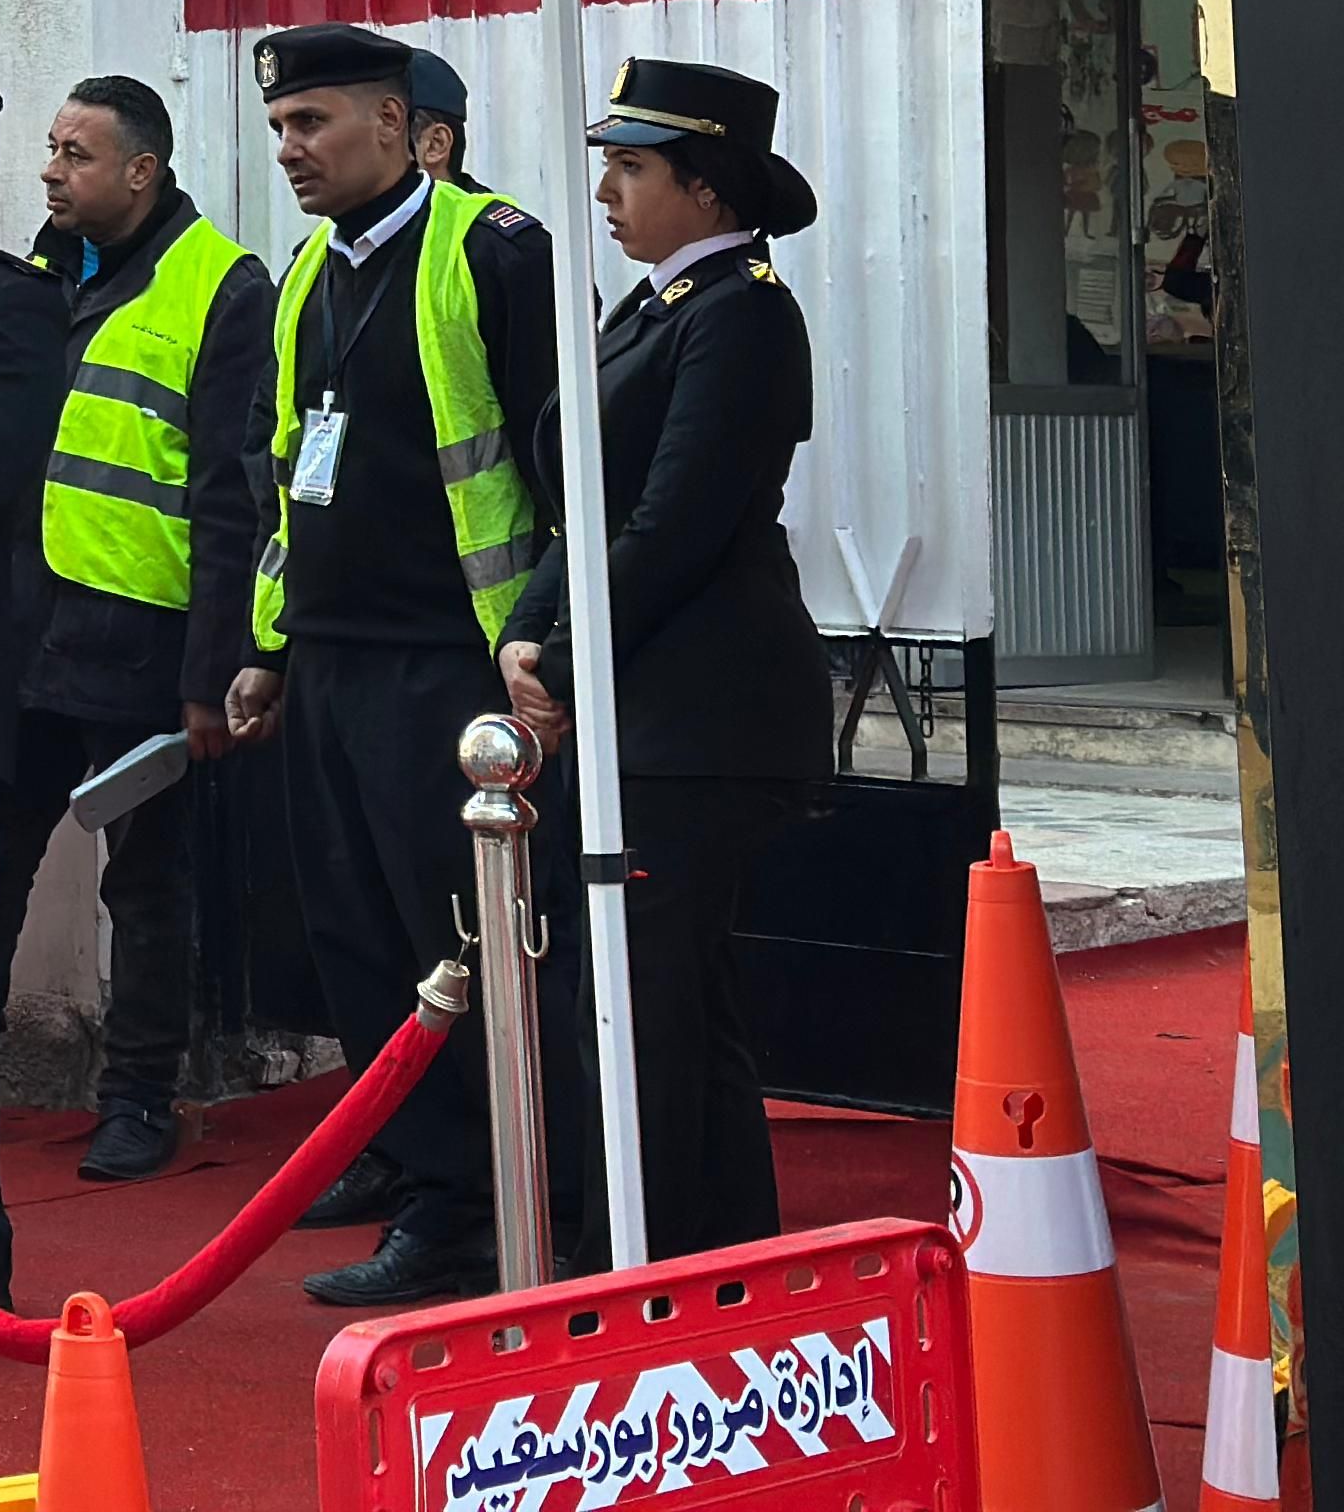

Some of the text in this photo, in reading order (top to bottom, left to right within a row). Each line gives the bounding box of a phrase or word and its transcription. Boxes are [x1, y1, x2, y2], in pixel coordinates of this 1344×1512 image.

[449, 1342, 873, 1509] إدارة مرور بورسعيد
